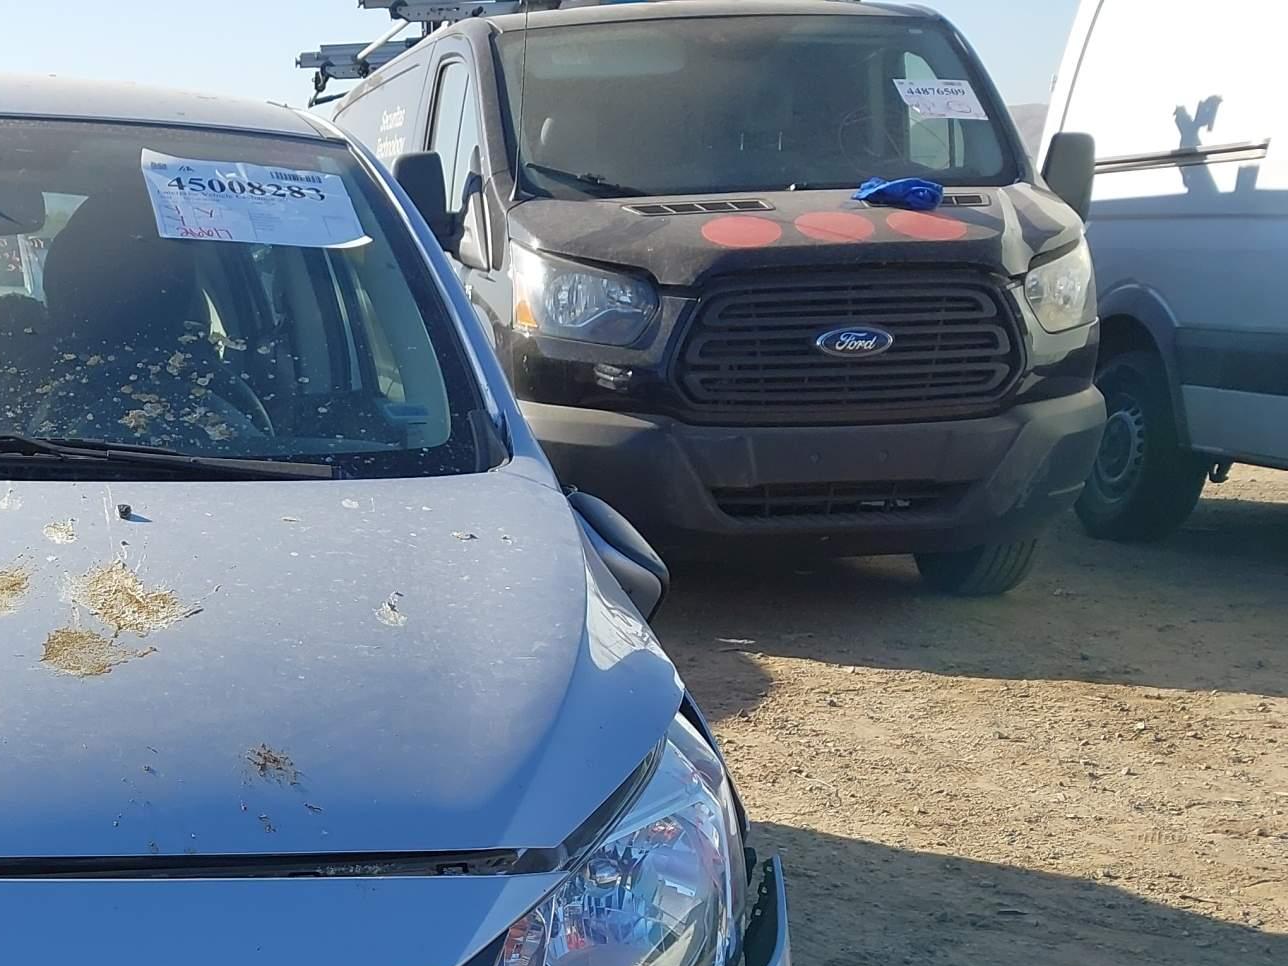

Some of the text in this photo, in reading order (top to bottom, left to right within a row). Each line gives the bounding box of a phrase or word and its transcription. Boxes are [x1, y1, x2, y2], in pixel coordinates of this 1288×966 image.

[906, 87, 966, 97] 44876509
[167, 176, 326, 202] 45008283
[835, 332, 877, 351] Ford
